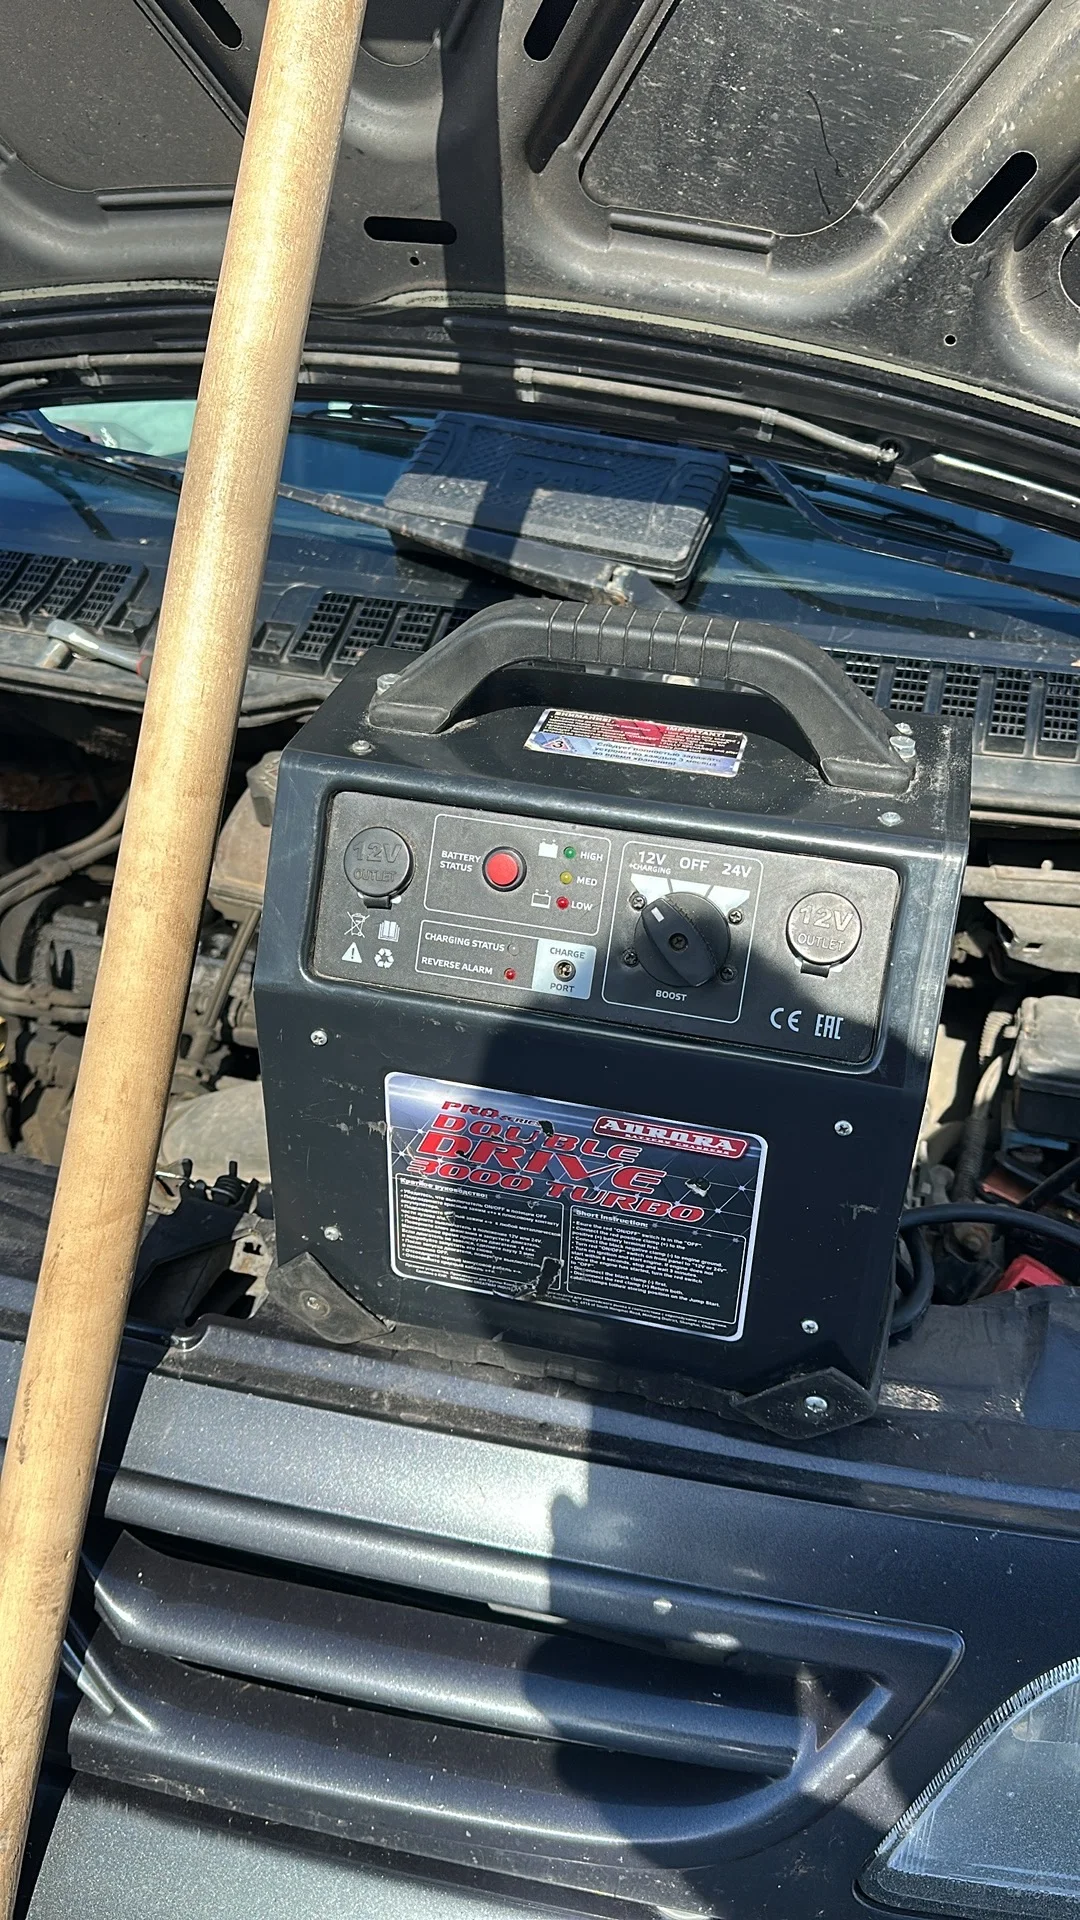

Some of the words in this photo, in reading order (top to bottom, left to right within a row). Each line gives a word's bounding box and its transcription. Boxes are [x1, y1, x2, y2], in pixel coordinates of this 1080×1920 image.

[551, 740, 565, 749] 3
[353, 841, 401, 864] 12V
[441, 850, 482, 863] BATTERY
[580, 850, 603, 862] HIGH
[638, 851, 666, 865] 12V
[439, 860, 473, 873] STATUS
[679, 857, 710, 872] OFF
[721, 863, 752, 878] 24V
[353, 868, 397, 883] OUTLET
[576, 876, 598, 886] MED
[571, 901, 593, 911] LOW
[799, 904, 854, 932] 12V
[424, 932, 470, 948] CHARGING
[471, 940, 505, 952] STATUS
[797, 934, 845, 952] OUTLET
[549, 946, 586, 960] CHARGE
[421, 956, 461, 970] REVERSE
[461, 964, 493, 975] ALARM
[549, 983, 575, 993] PORT
[655, 990, 687, 1002] BOOST
[441, 1100, 500, 1119] PRO
[430, 1112, 643, 1164] DOUBLE
[600, 1119, 737, 1152] AURORA
[416, 1131, 667, 1195] DRIVE
[405, 1156, 534, 1192] 3000
[545, 1180, 705, 1223] TURBO
[576, 1209, 598, 1219] Short
[601, 1214, 648, 1228] Instruction:
